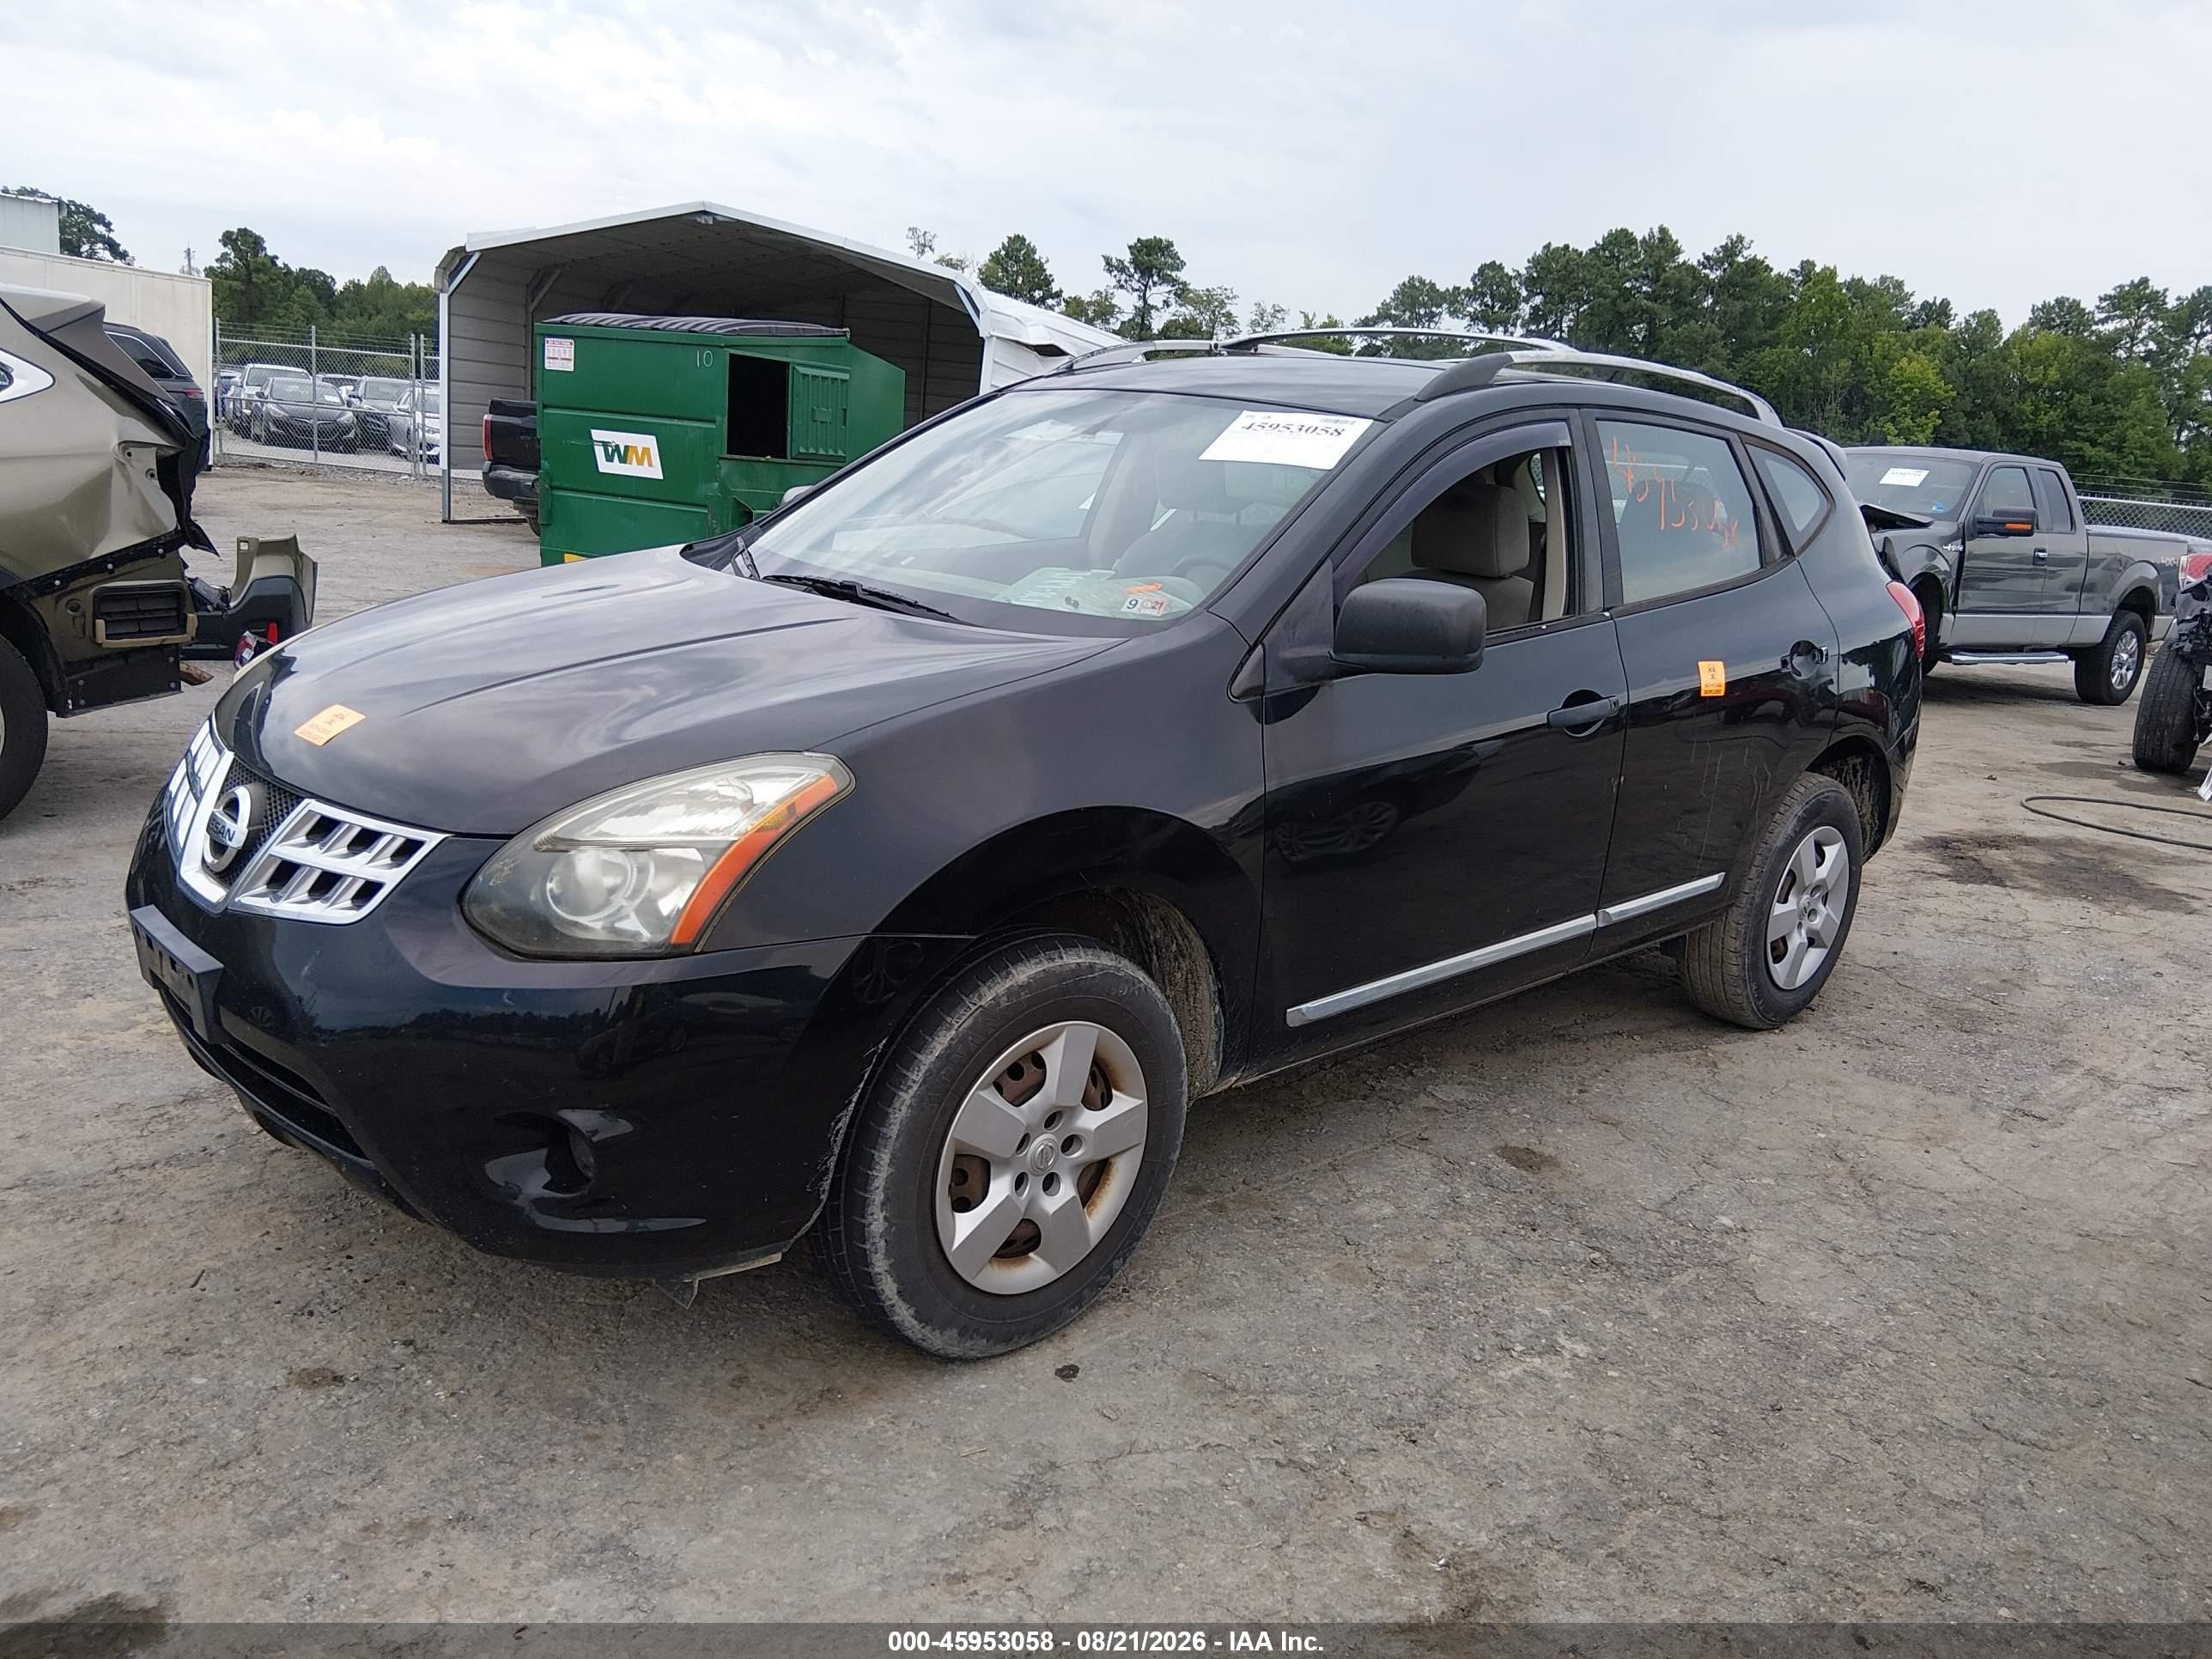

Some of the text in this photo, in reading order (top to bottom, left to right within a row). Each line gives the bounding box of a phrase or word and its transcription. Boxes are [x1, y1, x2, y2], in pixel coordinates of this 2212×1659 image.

[696, 349, 714, 368] 10
[1242, 422, 1346, 438] 45953058
[603, 443, 653, 468] WM
[1126, 599, 1139, 610] 9
